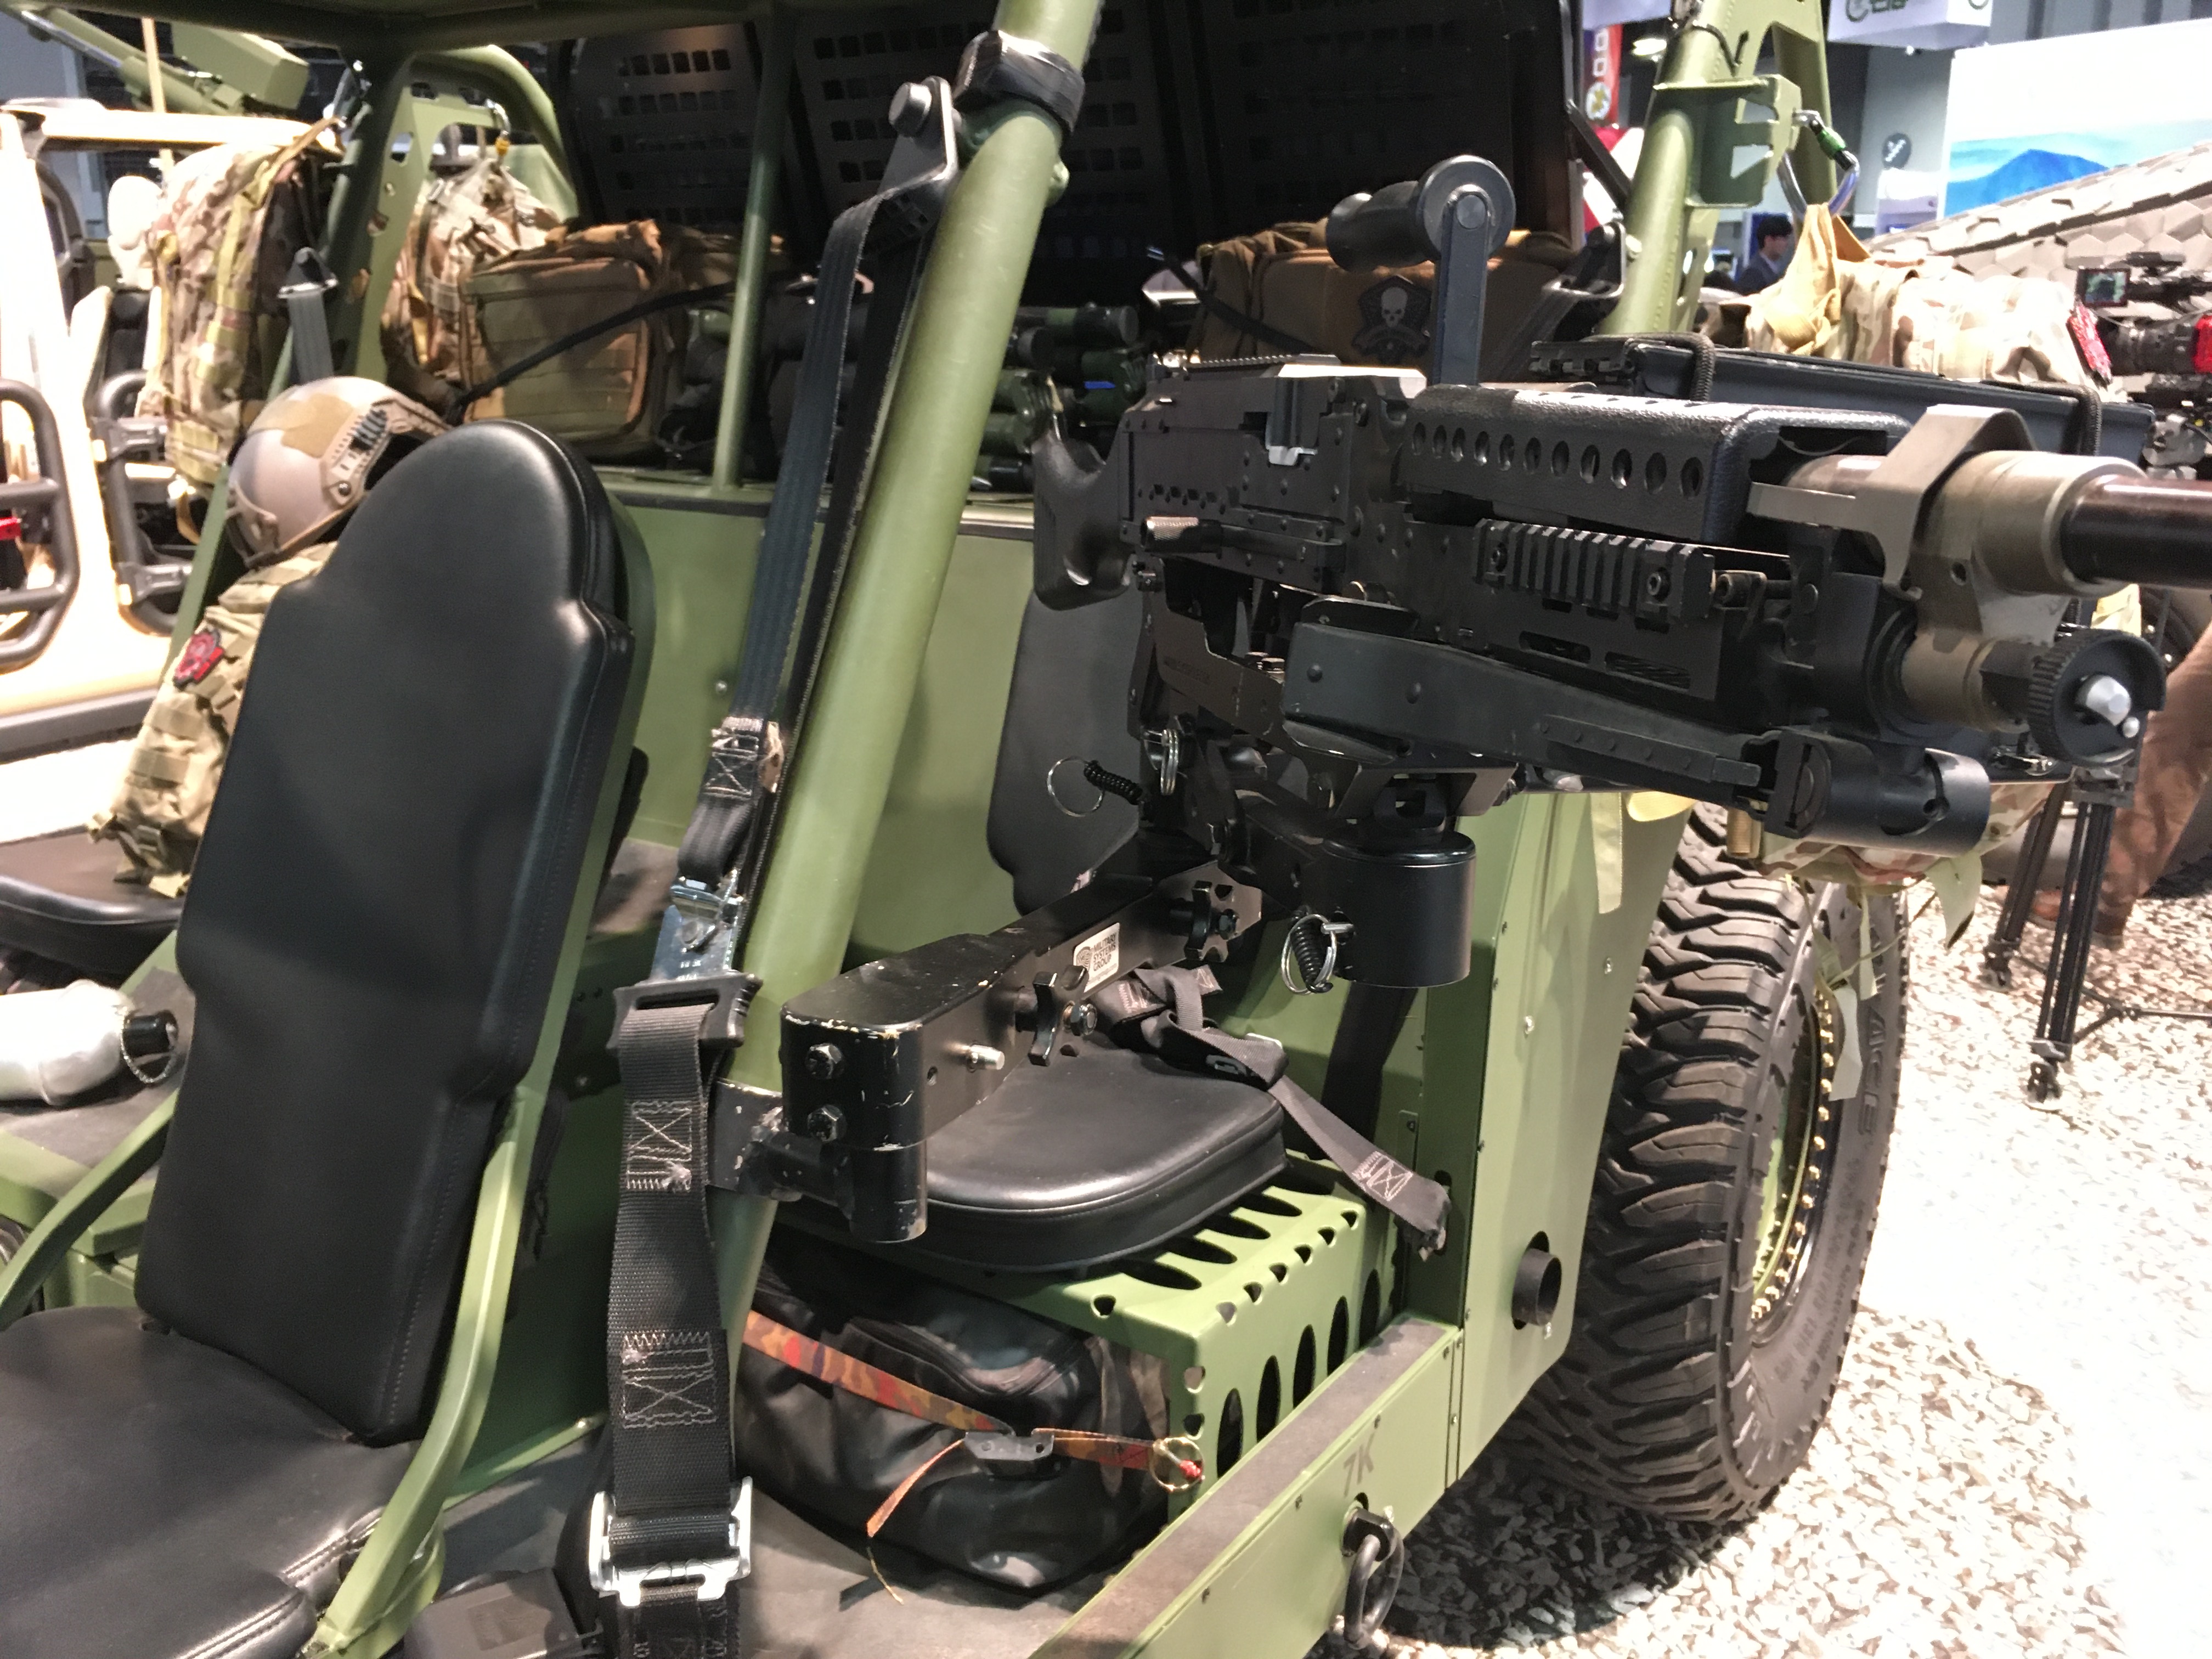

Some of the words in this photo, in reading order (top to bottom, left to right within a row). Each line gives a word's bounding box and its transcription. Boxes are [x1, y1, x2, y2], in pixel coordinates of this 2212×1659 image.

[1093, 932, 1116, 952] MILITARY
[1093, 942, 1116, 963] SYSTEMS
[1093, 953, 1111, 971] GROUP
